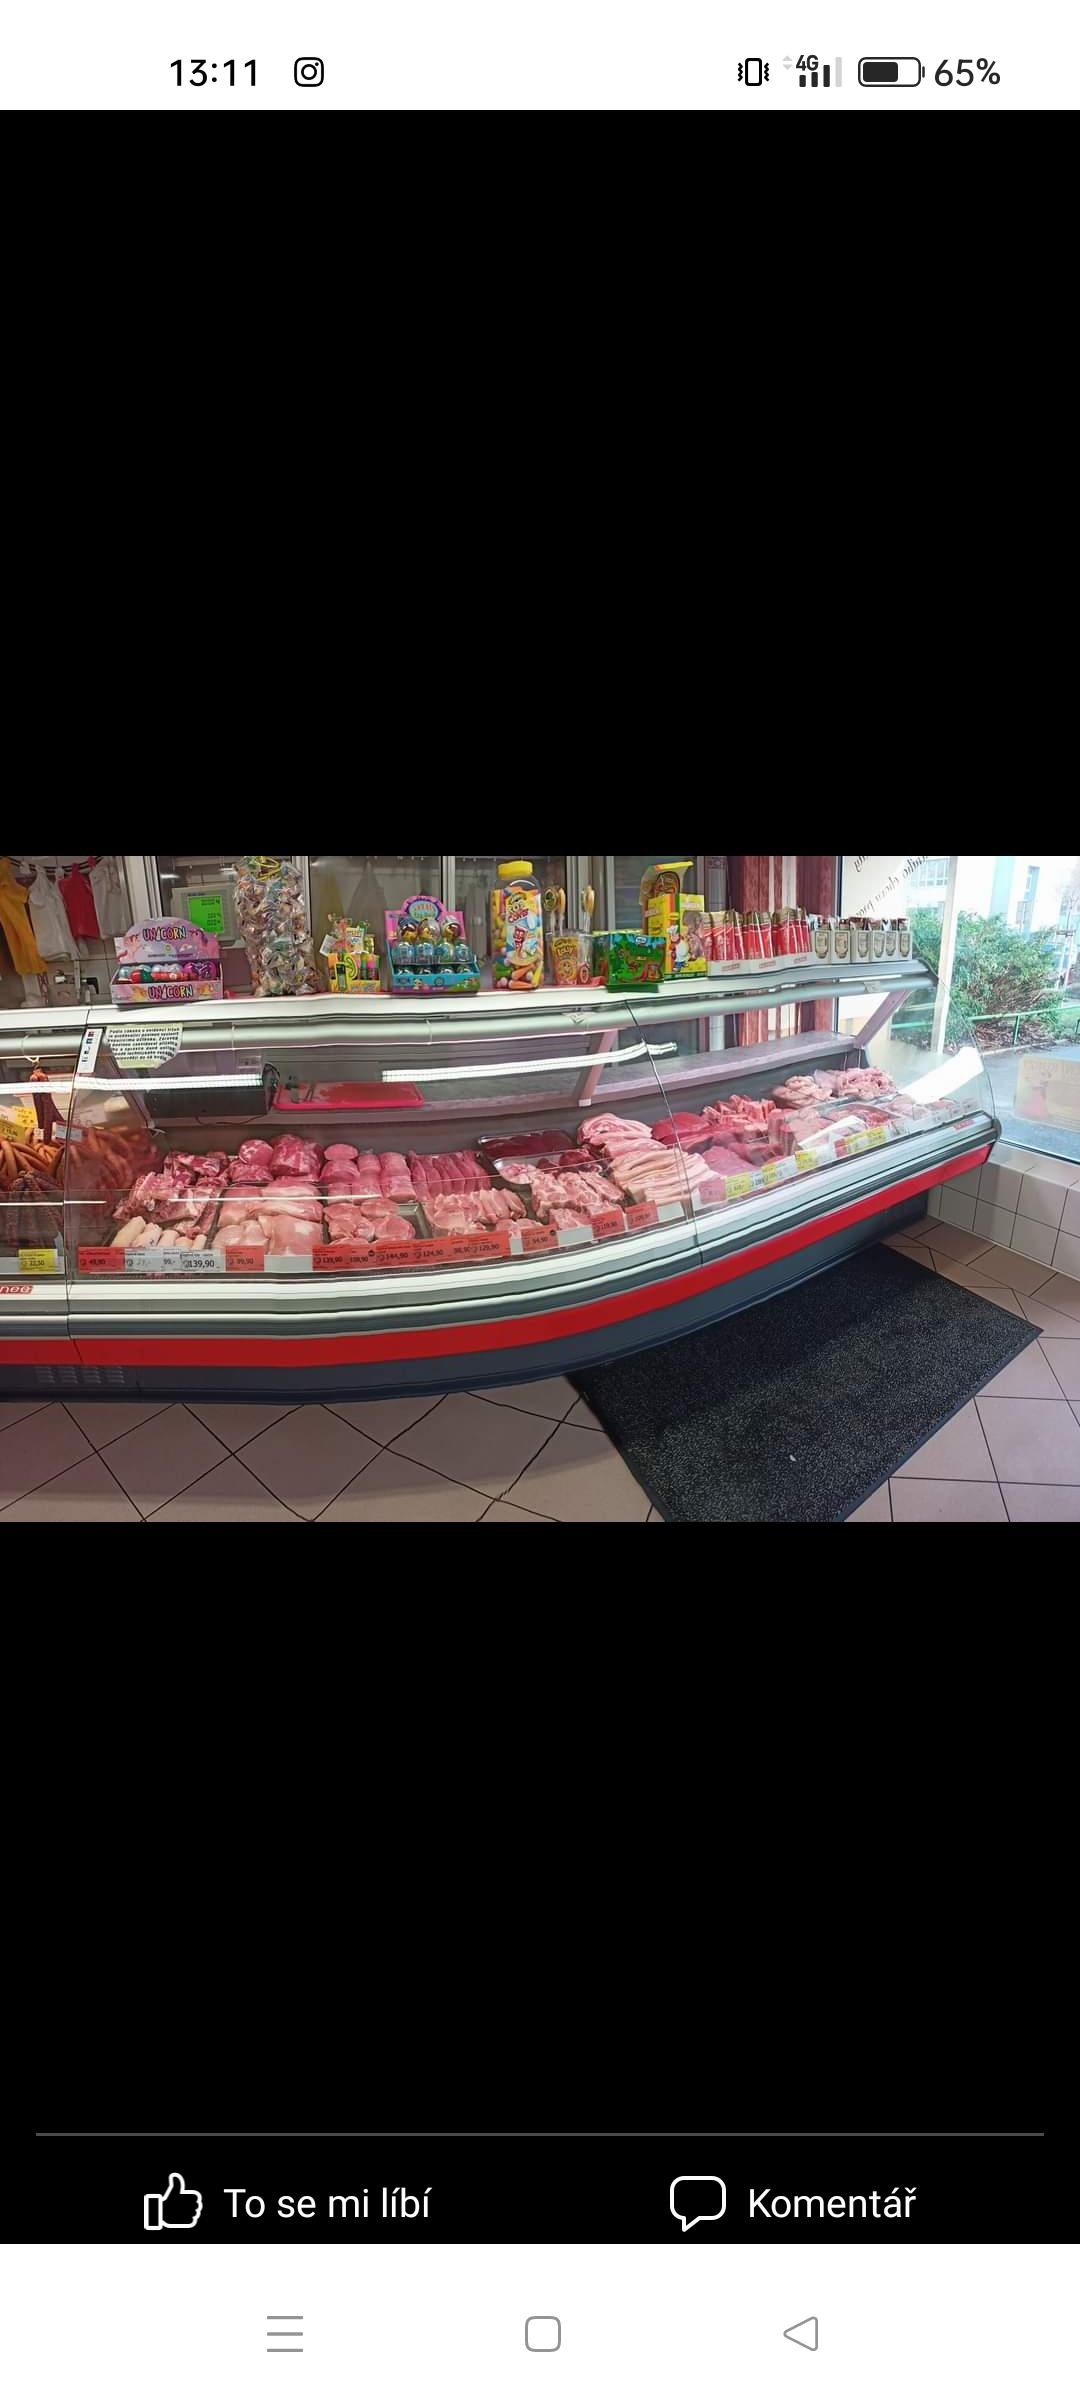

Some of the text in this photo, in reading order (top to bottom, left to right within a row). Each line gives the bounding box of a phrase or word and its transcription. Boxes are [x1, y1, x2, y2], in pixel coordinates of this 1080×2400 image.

[143, 926, 187, 941] UNICORN
[147, 984, 193, 1000] UNICORN
[188, 1259, 215, 1268] 139,90
